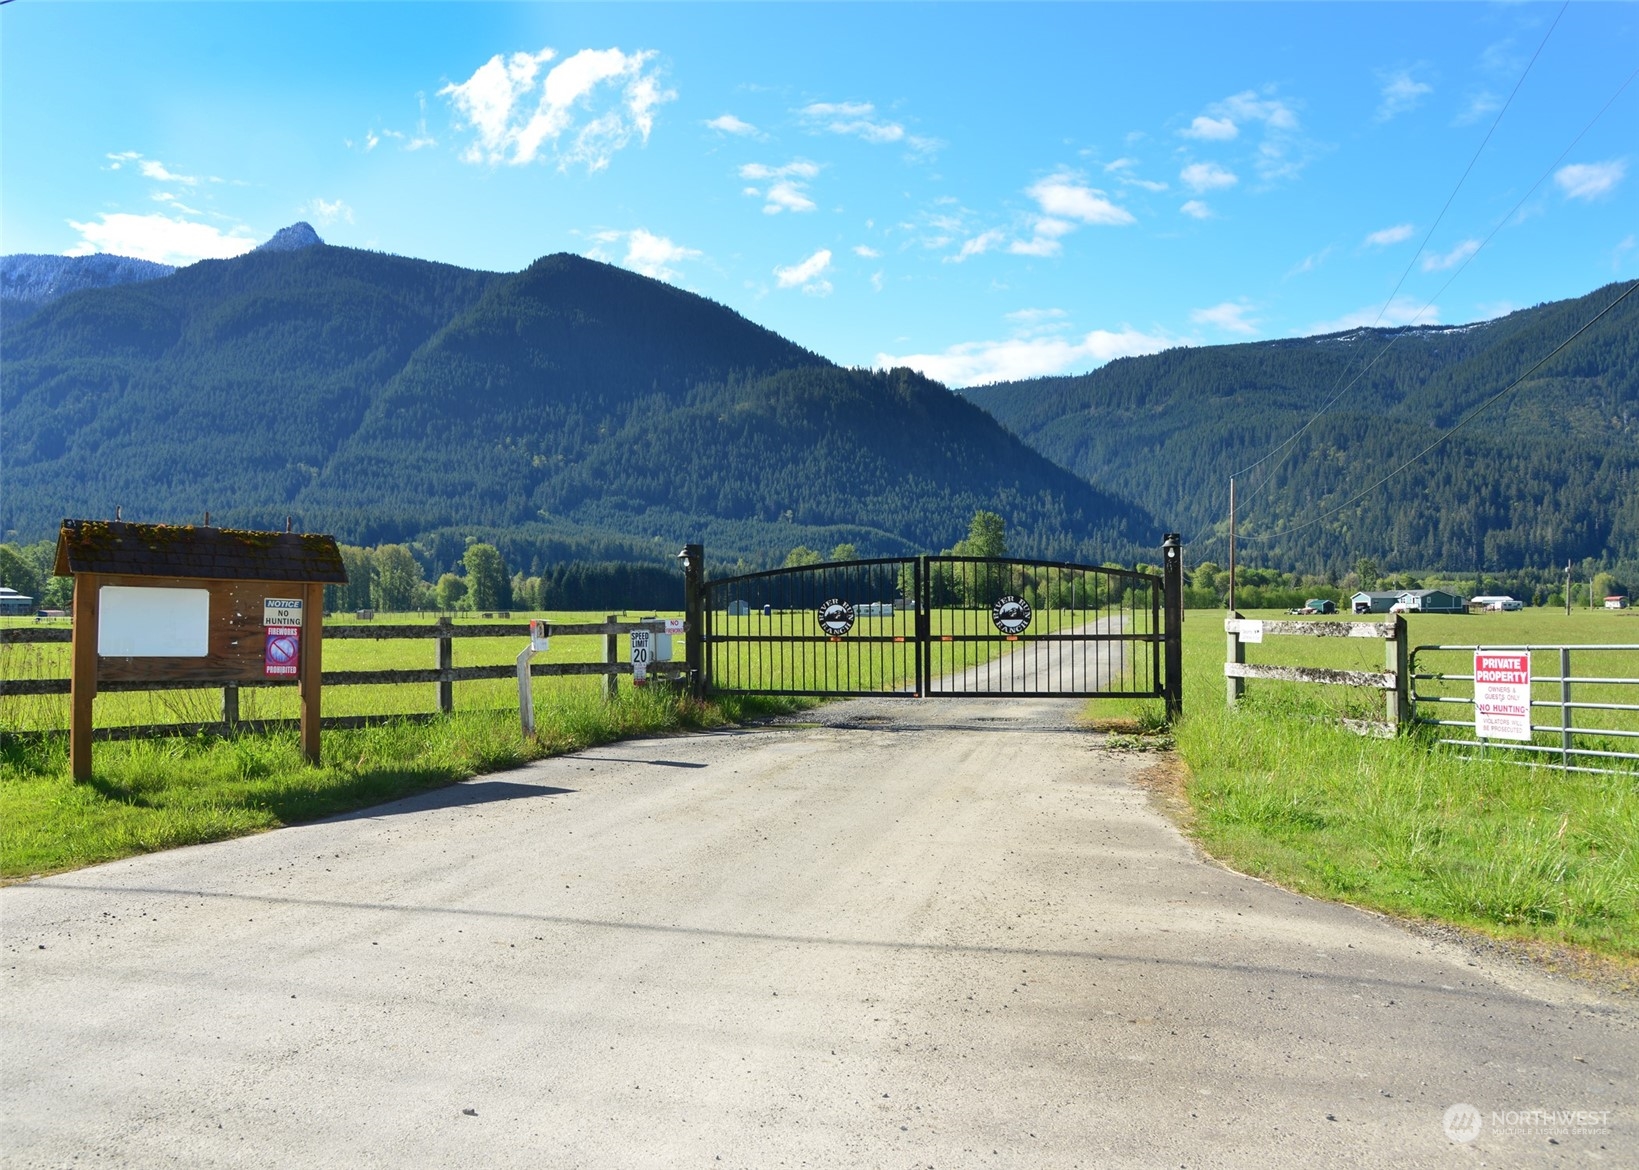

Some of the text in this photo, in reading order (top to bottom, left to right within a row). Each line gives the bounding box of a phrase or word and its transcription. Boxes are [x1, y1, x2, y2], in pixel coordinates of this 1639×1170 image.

[267, 600, 300, 608] NOTICE
[993, 595, 1031, 620] RIVER RUN
[819, 598, 854, 621] RIVER RUN
[265, 617, 301, 625] HUNTING
[268, 627, 298, 636] FIREWORKS
[821, 622, 852, 635] RANCH
[996, 620, 1029, 634] RANCH
[631, 632, 649, 640] SPEED
[632, 640, 648, 648] LIMIT
[633, 648, 647, 663] 20
[1482, 657, 1521, 670] PRIVATE
[266, 665, 297, 674] PROHIBITED
[1477, 670, 1527, 683] PROPERTY
[1485, 693, 1505, 701] GUESTS
[1480, 703, 1526, 713] NO HUNTING
[1491, 725, 1523, 733] PROSECUTED
